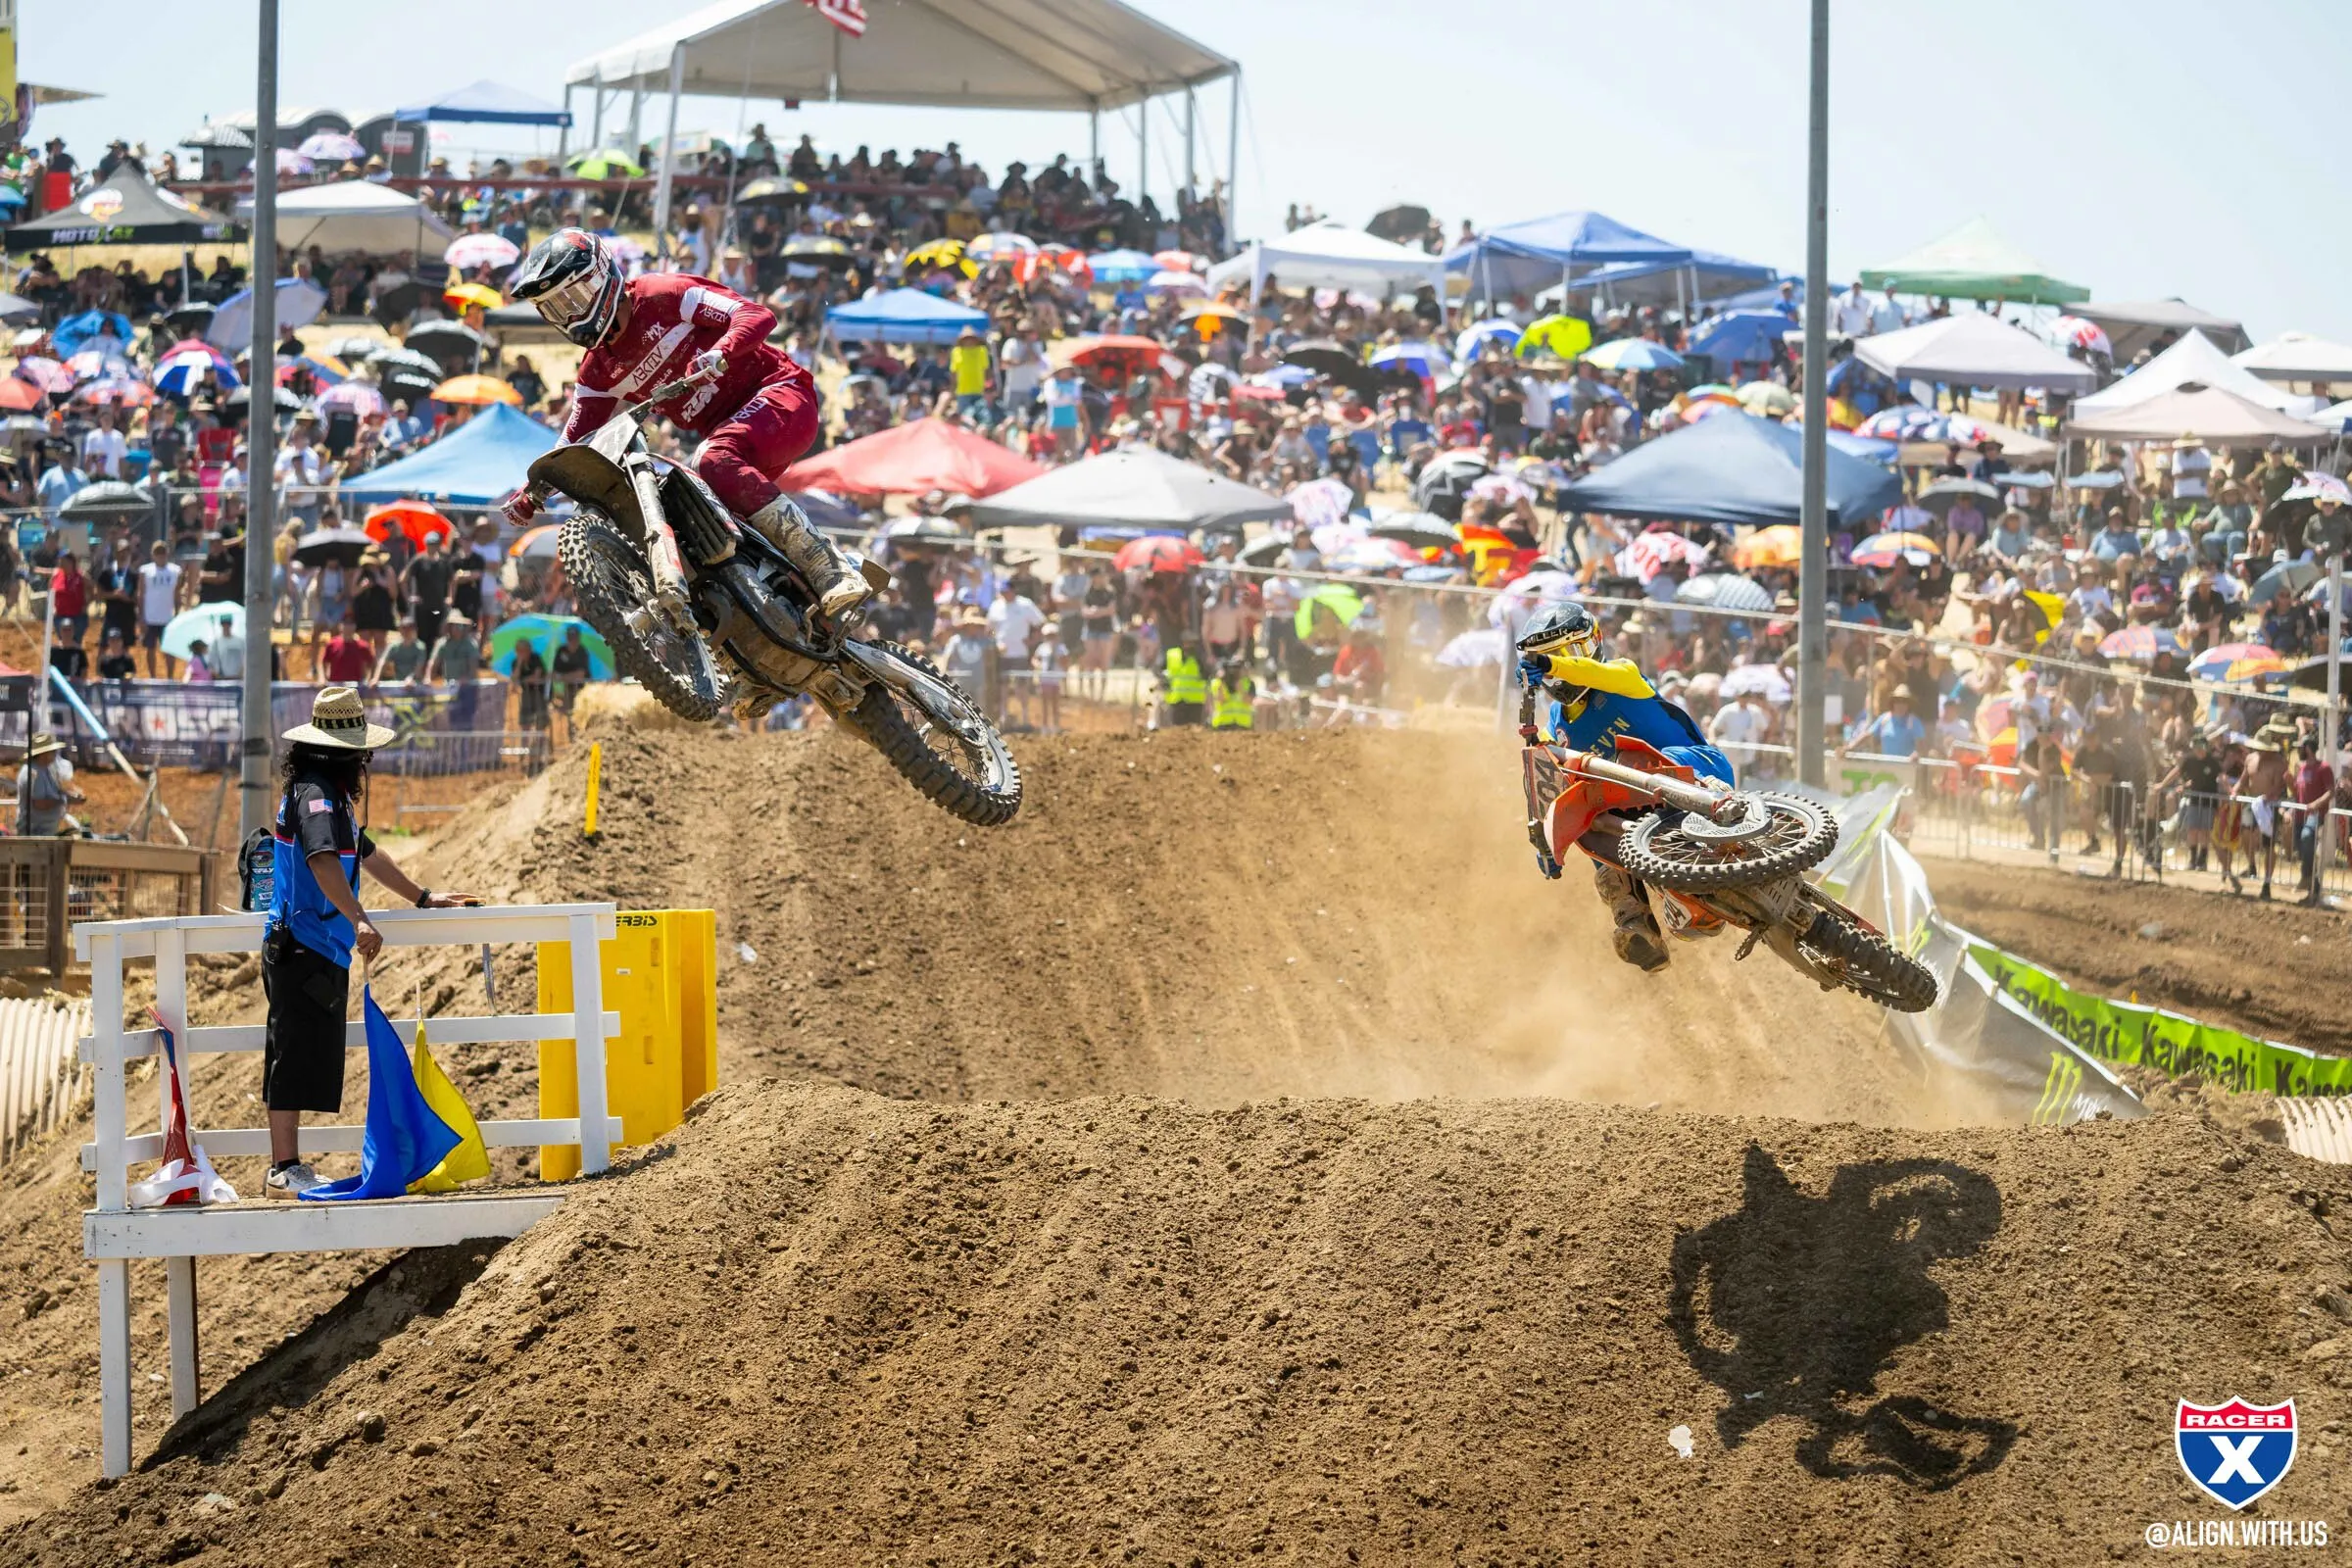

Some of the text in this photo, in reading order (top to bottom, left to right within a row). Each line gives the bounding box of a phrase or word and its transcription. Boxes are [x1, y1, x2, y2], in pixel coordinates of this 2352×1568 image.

[1526, 627, 1568, 646] MILLER
[1995, 964, 2122, 1059] Kawasaki
[2139, 1021, 2256, 1094] Kawasaki
